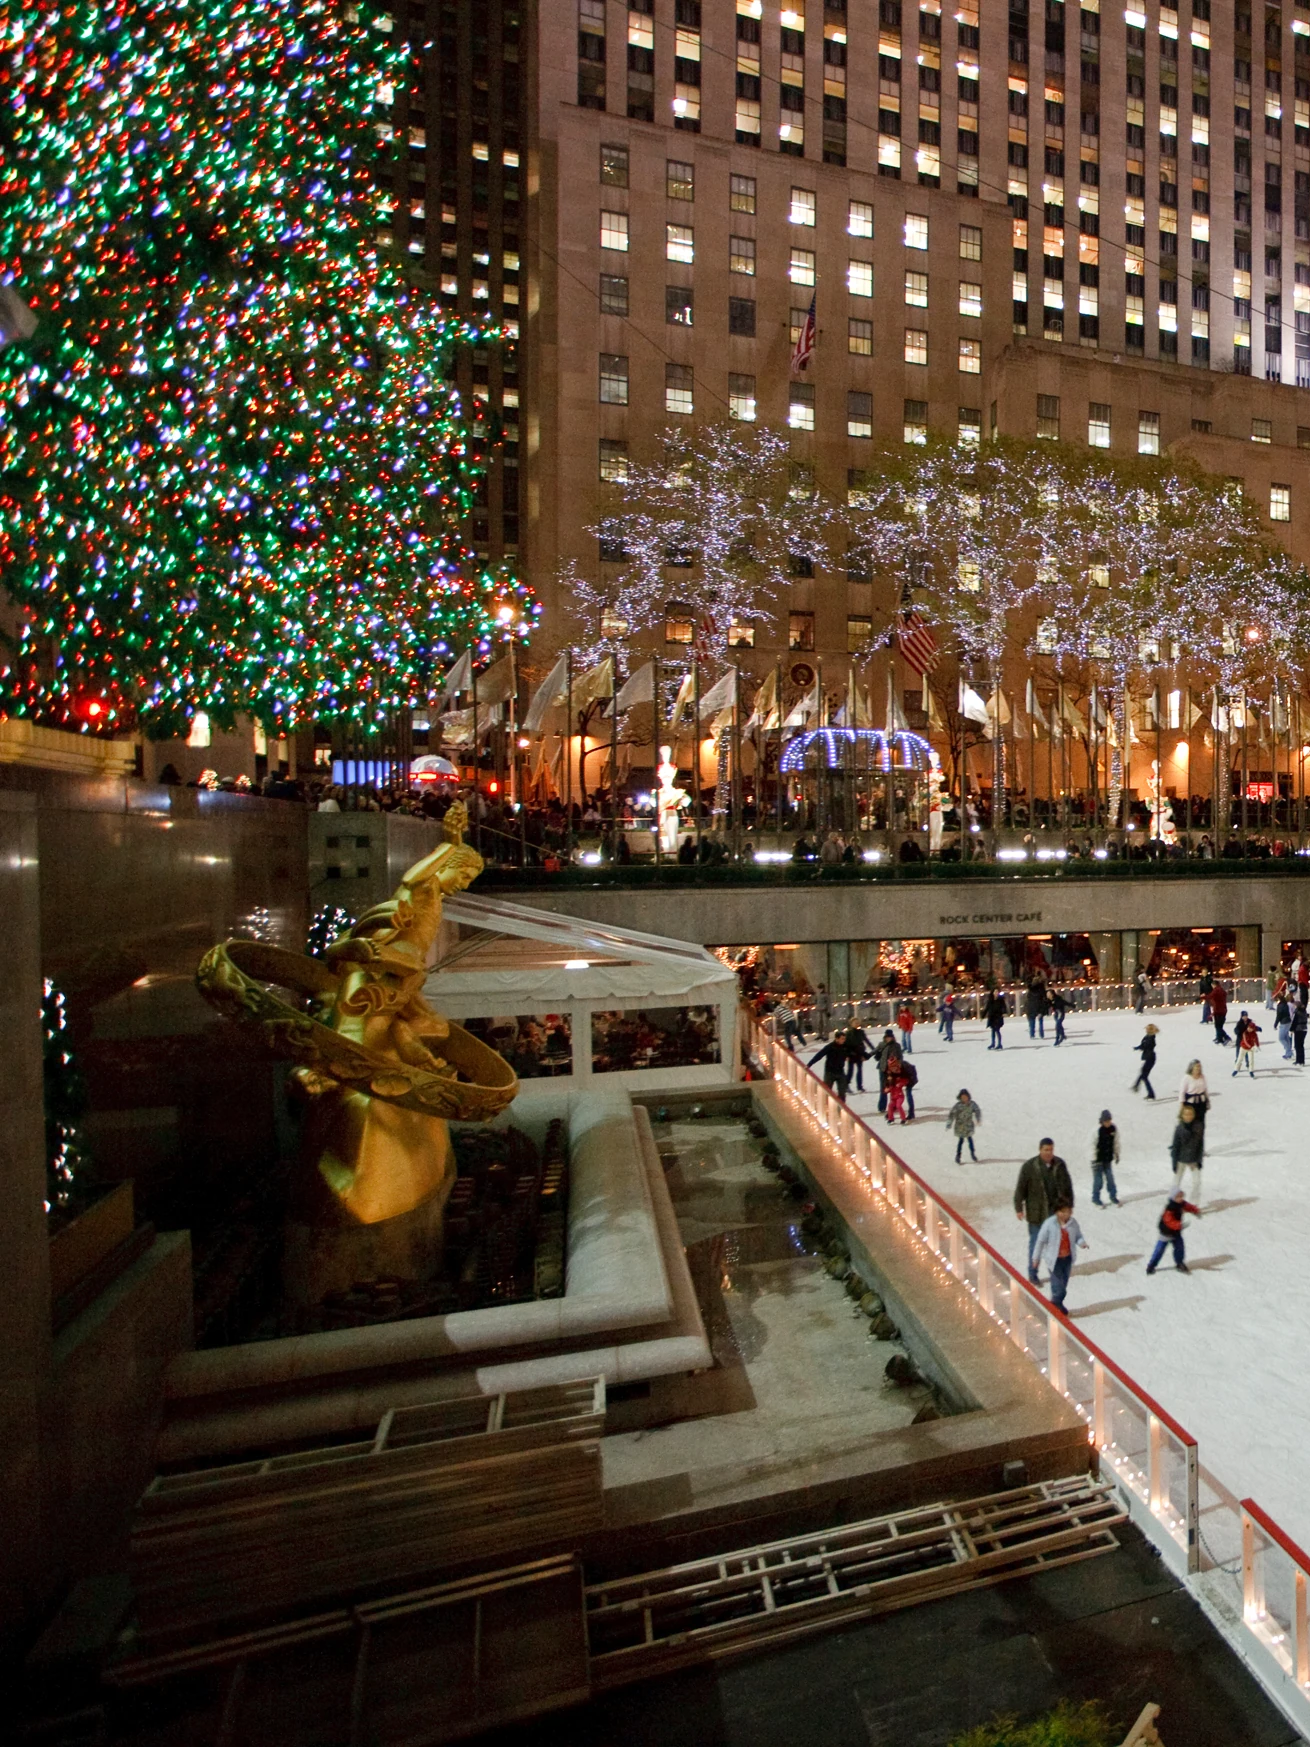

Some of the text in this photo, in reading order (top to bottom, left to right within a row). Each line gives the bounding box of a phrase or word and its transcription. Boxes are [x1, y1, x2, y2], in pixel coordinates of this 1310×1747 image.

[940, 911, 1042, 925] ROCK CENTER CAFÉ
